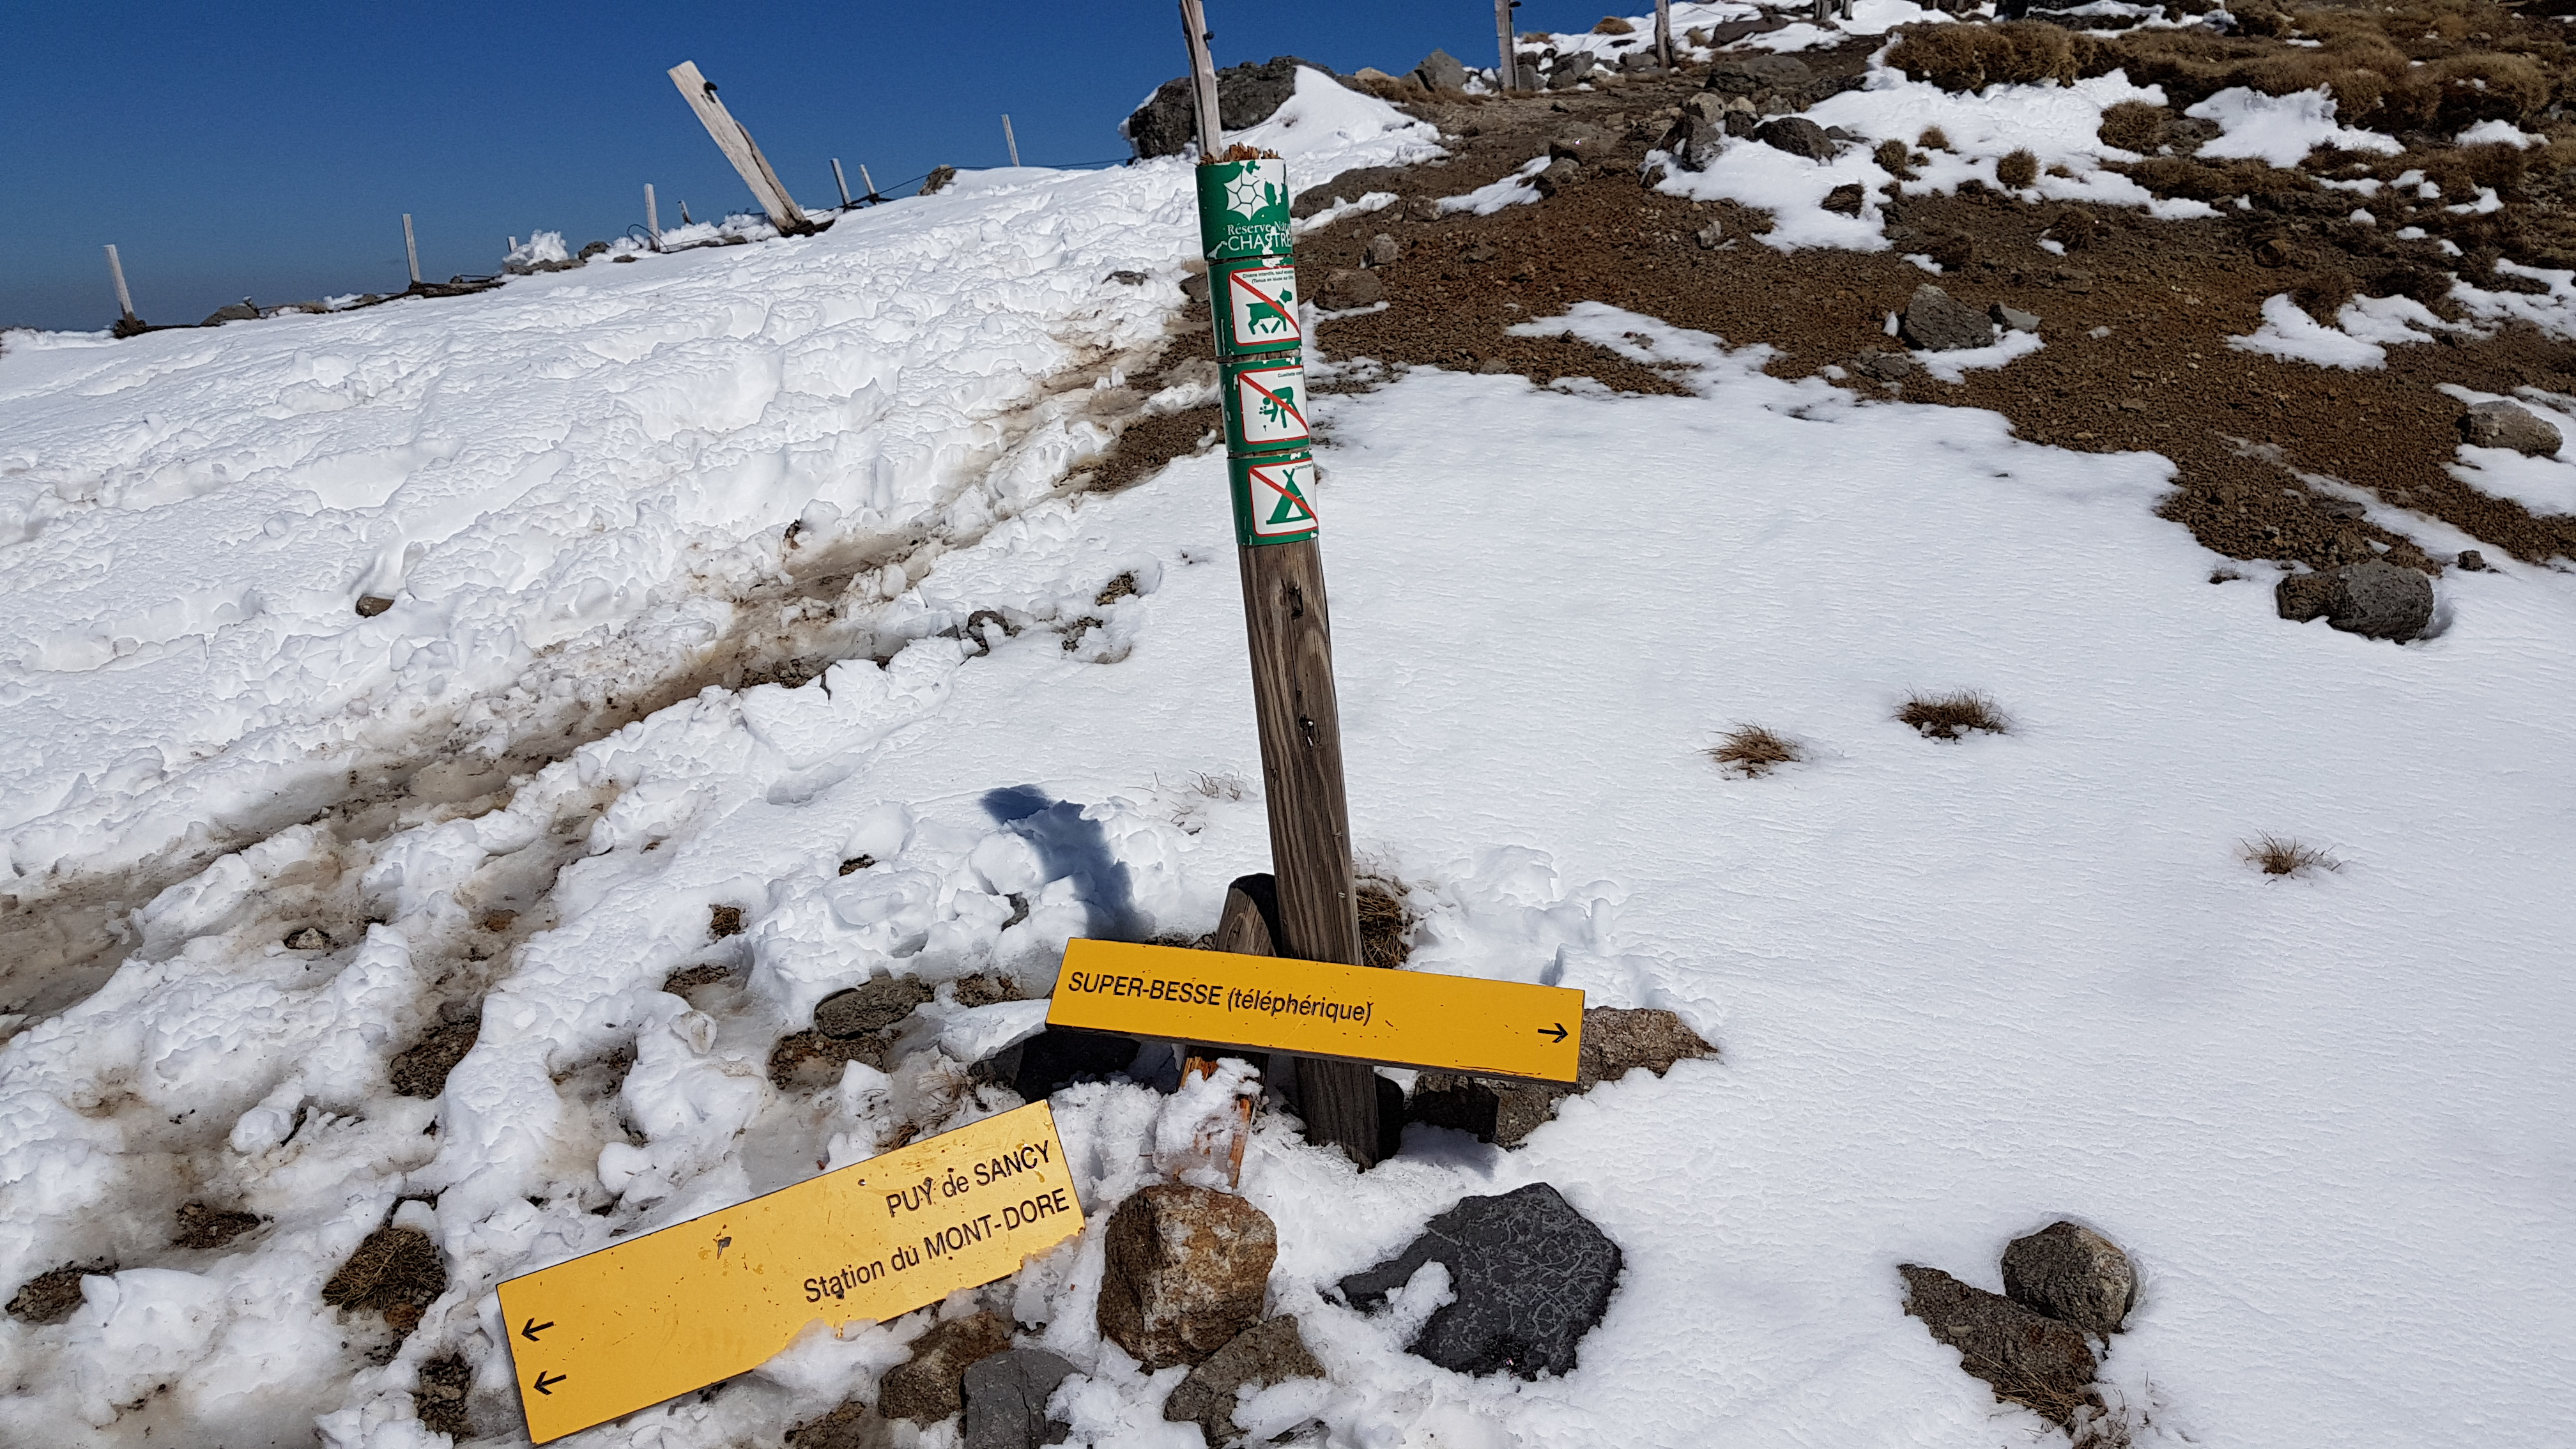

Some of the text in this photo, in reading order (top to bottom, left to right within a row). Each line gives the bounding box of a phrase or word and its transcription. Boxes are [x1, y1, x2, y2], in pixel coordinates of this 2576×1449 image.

[1227, 222, 1271, 236] Réserve
[1068, 972, 1373, 1027] SUPER-BESSE (téléphérique)
[886, 1140, 1050, 1218] PUY de SANCY
[804, 1188, 1070, 1303] Station du MONT-DORE
